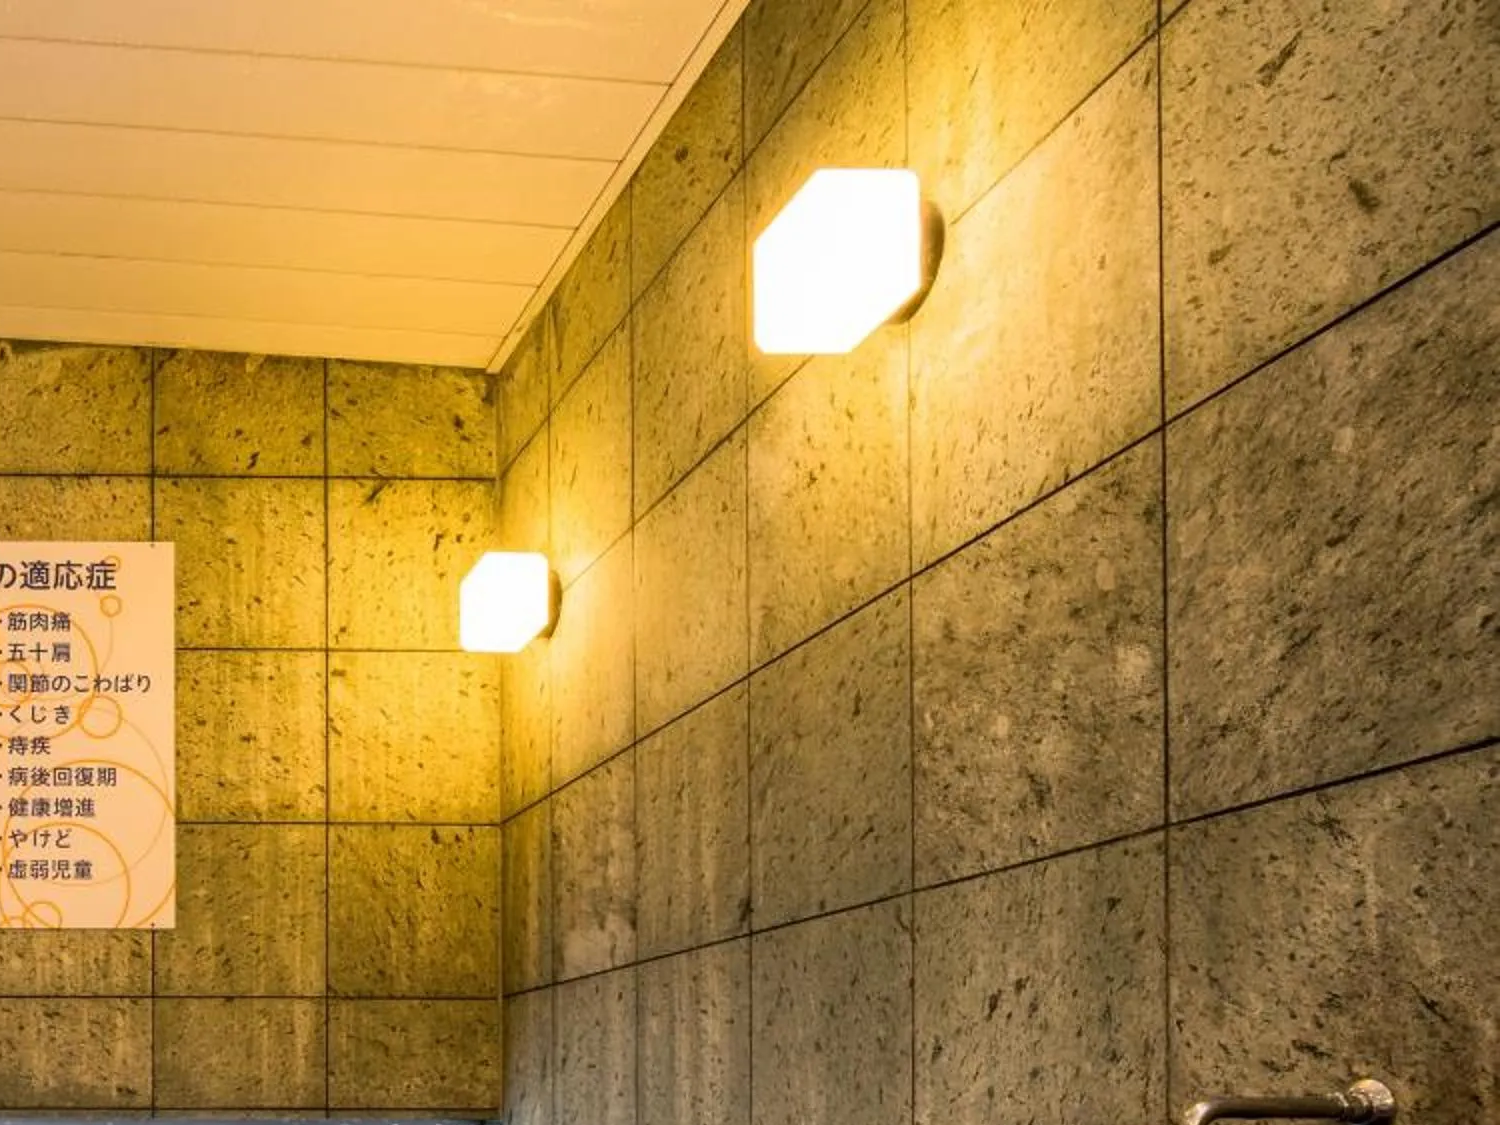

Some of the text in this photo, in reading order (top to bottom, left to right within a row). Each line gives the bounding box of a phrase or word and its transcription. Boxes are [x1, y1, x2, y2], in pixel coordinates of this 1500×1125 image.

[7, 611, 71, 632] 筋肉痛
[7, 642, 71, 663] 五十肩
[8, 673, 151, 693] 関節のこわばり
[9, 705, 69, 725] くじき
[7, 735, 51, 756] 痔疾
[8, 766, 117, 787] 病後回復期
[8, 797, 95, 817] 健康増進
[8, 829, 70, 849] やけど
[7, 859, 93, 880] 虚弱児童
